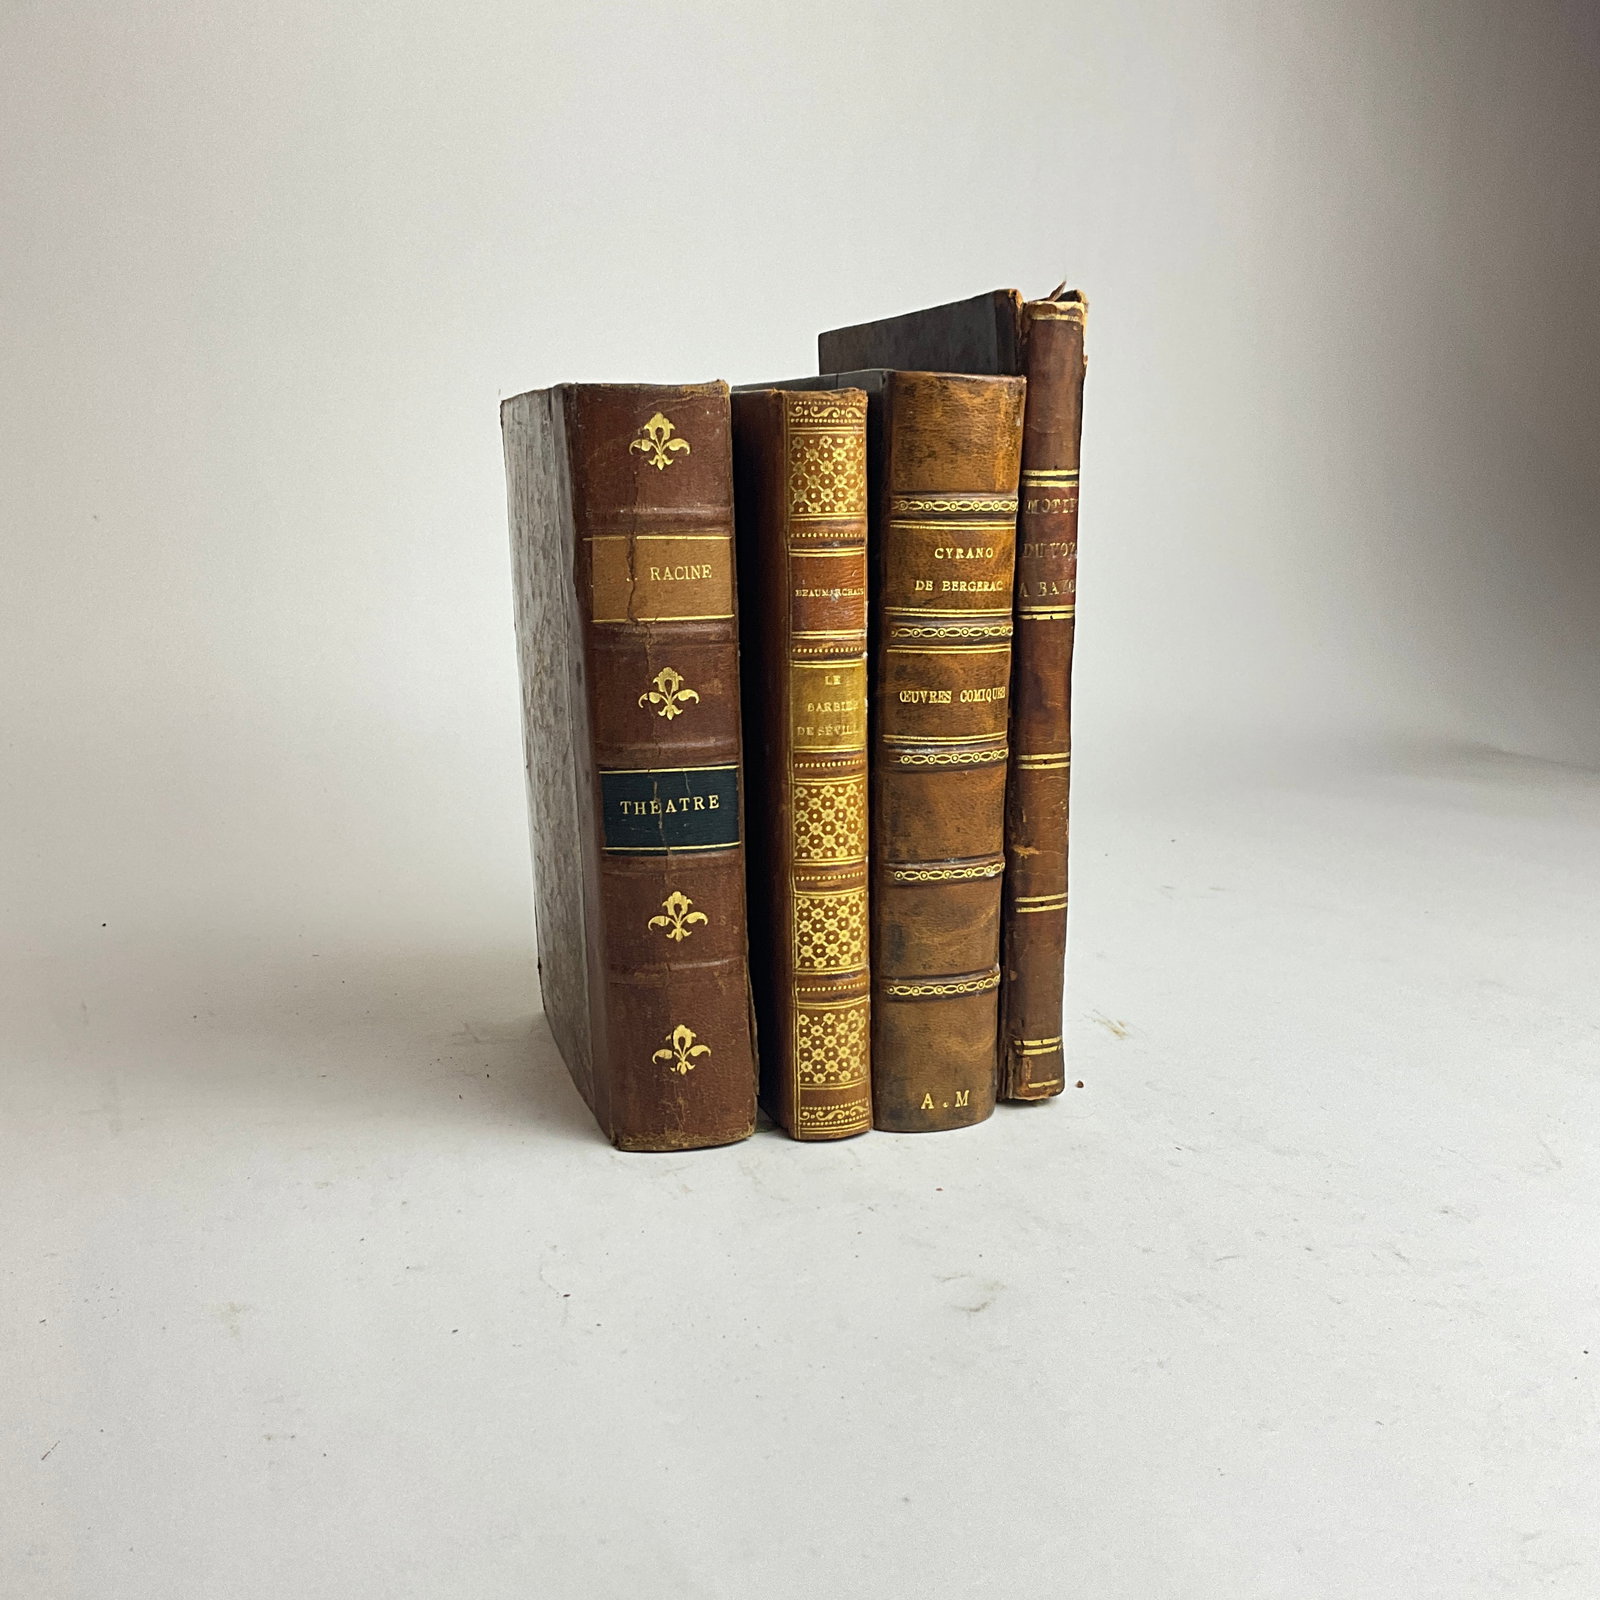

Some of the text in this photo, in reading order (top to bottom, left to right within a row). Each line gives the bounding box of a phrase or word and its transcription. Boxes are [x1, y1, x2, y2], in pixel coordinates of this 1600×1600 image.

[934, 547, 994, 559] CYRANO
[650, 564, 712, 581] RACINE
[915, 580, 1003, 592] DE BERGERAC
[825, 675, 841, 686] LE
[899, 686, 1006, 704] ŒUVRES COMIQUES
[797, 726, 815, 736] DE
